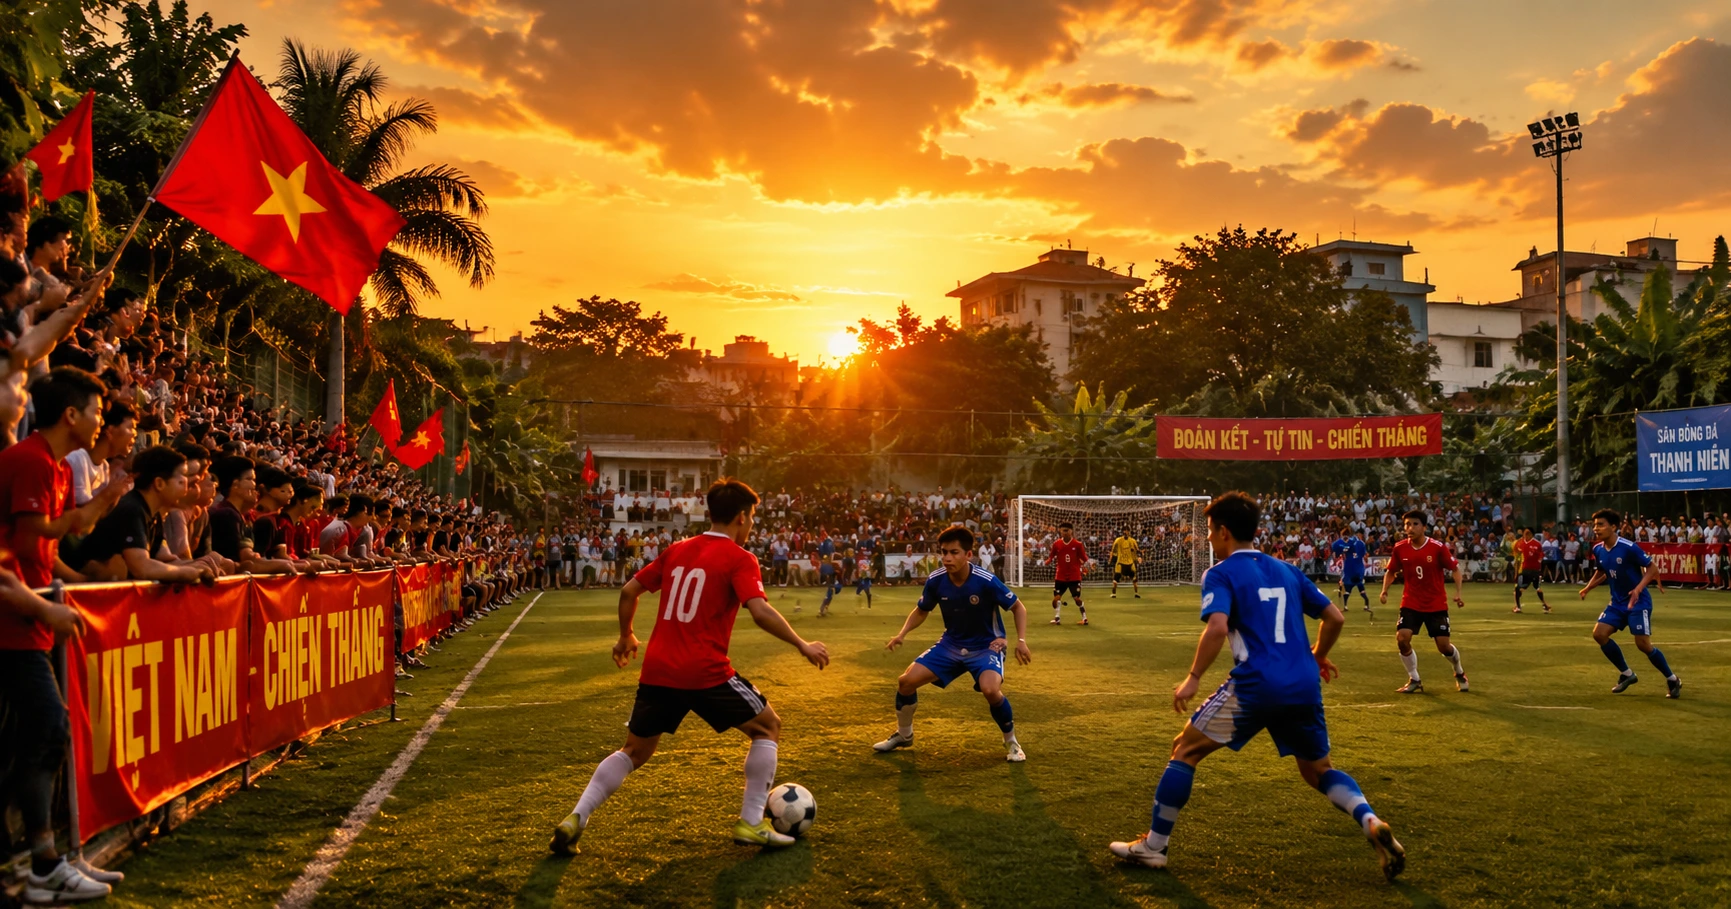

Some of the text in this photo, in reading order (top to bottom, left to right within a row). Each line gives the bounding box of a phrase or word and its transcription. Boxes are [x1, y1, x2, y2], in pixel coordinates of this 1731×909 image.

[1220, 423, 1249, 450] KẾT
[1288, 429, 1313, 450] TIN
[1327, 421, 1373, 450] CHIẾN
[1649, 450, 1693, 474] THANH
[1415, 565, 1424, 580] 9
[663, 566, 706, 623] 10
[1258, 587, 1287, 643] 7
[87, 612, 163, 791] VIỆT
[174, 628, 238, 744] NAM
